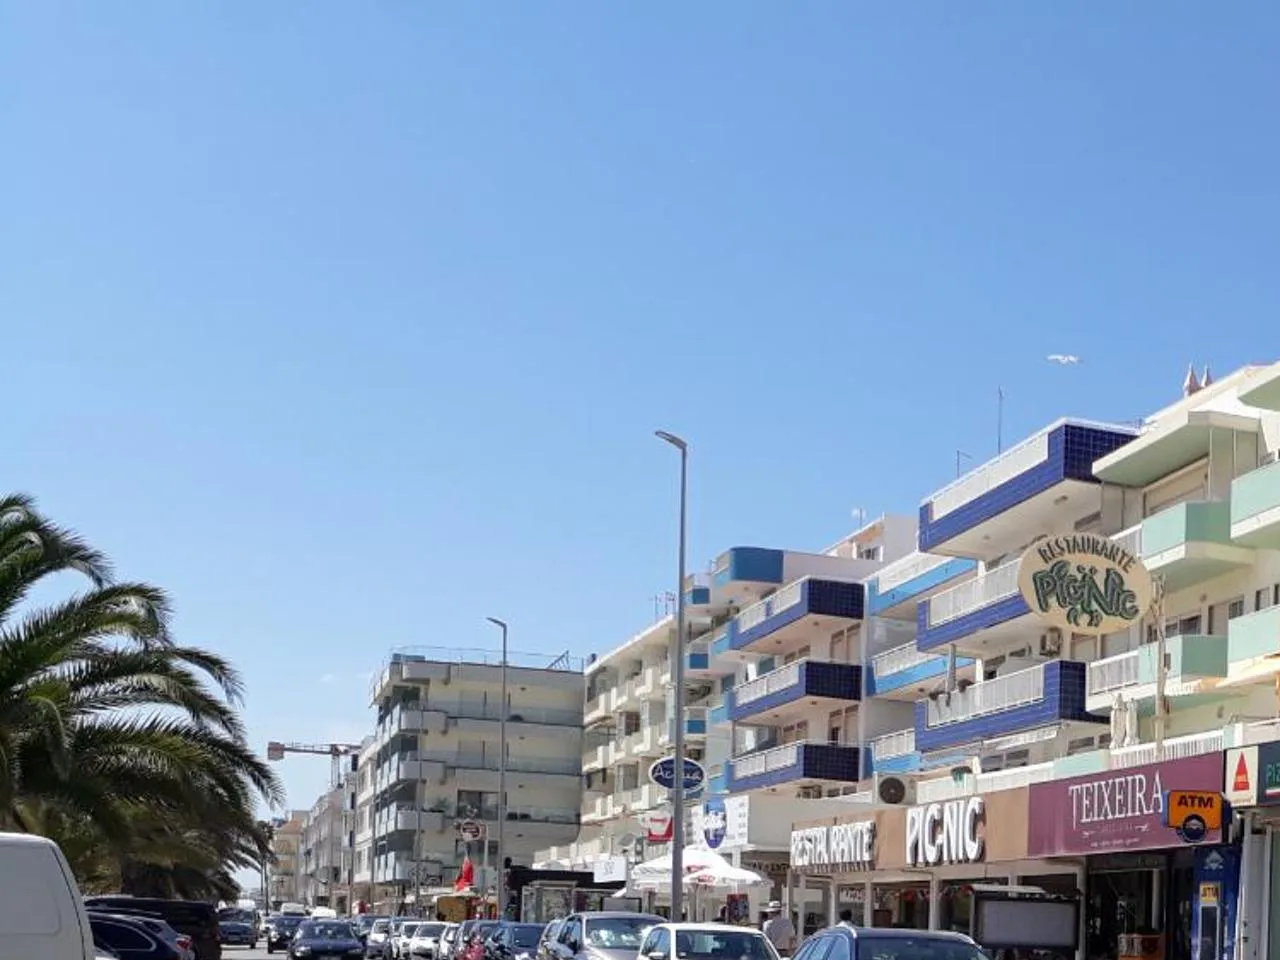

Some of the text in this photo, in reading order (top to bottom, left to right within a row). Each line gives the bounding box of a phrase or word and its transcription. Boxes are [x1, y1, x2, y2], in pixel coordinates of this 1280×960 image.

[1038, 535, 1136, 573] RESTAURANTE
[1068, 769, 1163, 831] TEIXEIRA
[1177, 794, 1214, 809] ATM
[790, 820, 876, 867] RESTAURANTE
[906, 796, 985, 865] PICNIC
